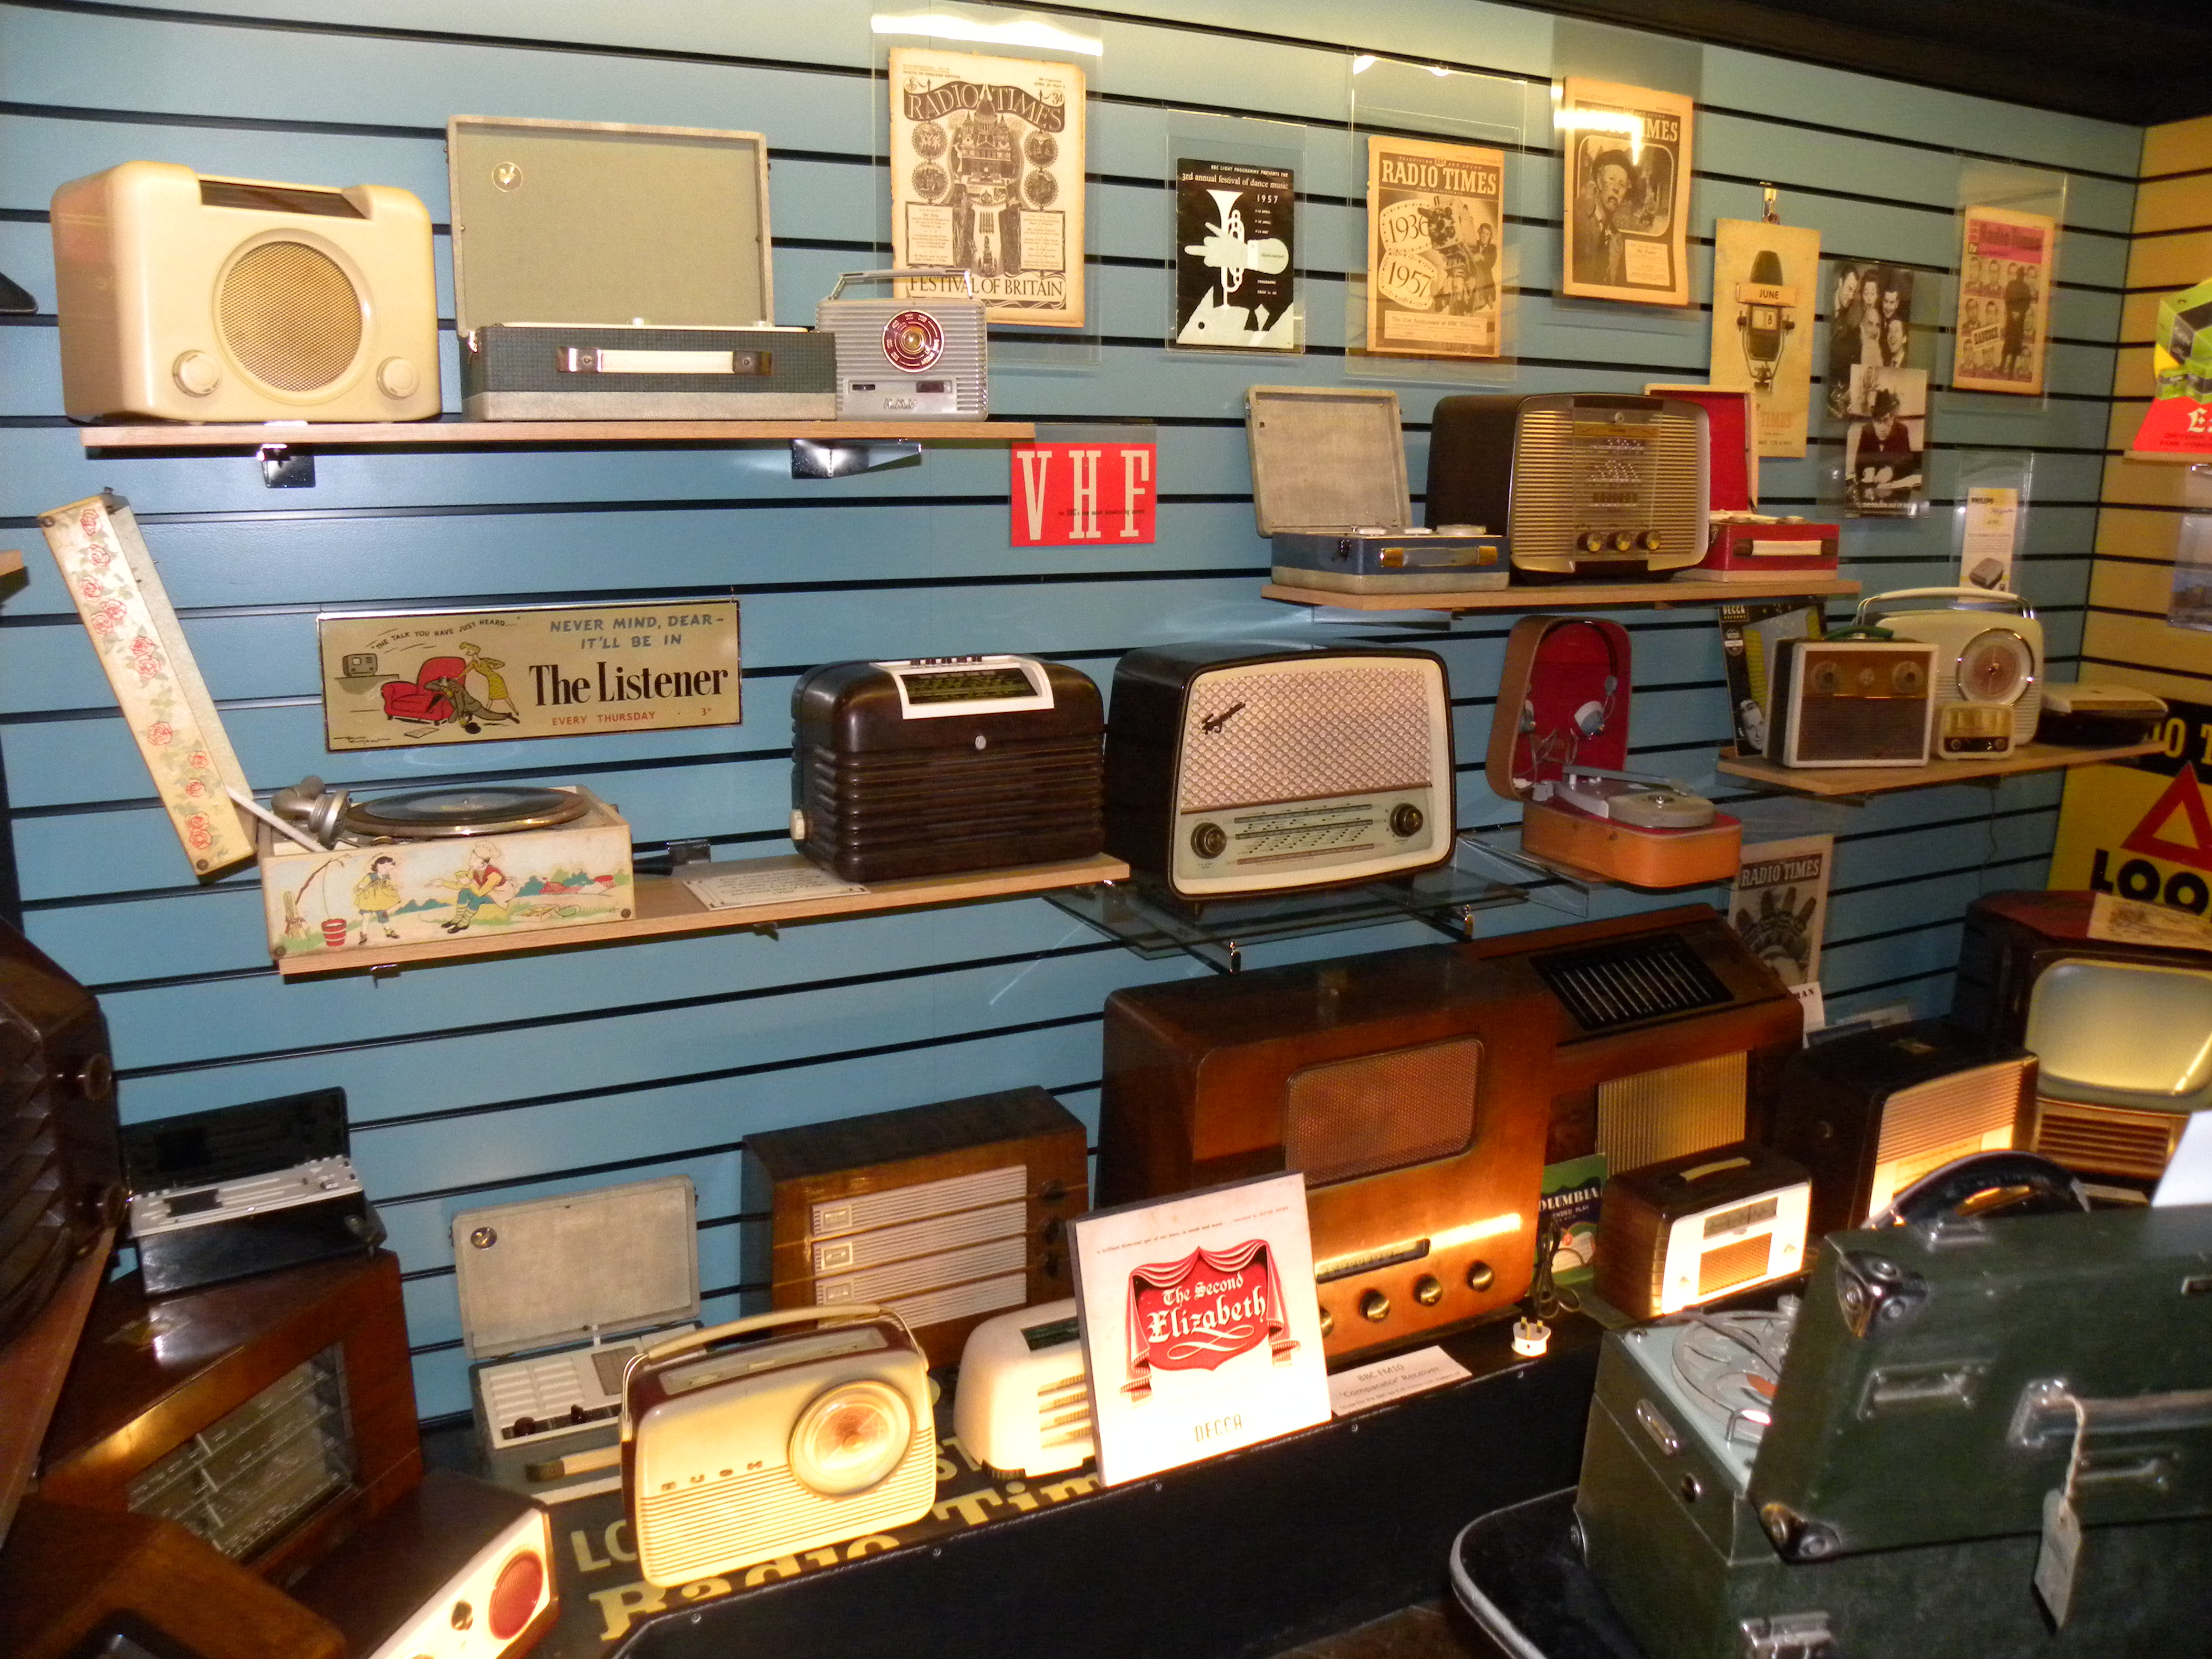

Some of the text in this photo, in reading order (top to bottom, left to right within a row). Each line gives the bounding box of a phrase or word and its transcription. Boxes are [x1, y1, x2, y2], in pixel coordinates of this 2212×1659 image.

[907, 84, 1062, 131] RADIO TIMES
[1182, 172, 1289, 190] 3rd annual festival of dance music
[1381, 159, 1497, 195] RADIO TIMES
[1256, 194, 1279, 205] 1957
[1388, 214, 1429, 243] 1936
[910, 276, 1063, 296] FESTIVAL OF BRITAIN
[1388, 261, 1432, 298] 1957
[1759, 289, 1780, 299] JUNE
[1767, 315, 1773, 325] 8
[1016, 450, 1149, 540] VHF
[1723, 605, 1745, 614] DECCA
[391, 632, 410, 641] TALK
[434, 628, 455, 637] HAVE
[458, 622, 477, 633] JUST
[550, 619, 604, 633] NEVER
[613, 616, 662, 630] MIND,
[581, 634, 683, 650] IT'LL BE IN
[529, 661, 729, 707] The Listener
[552, 715, 588, 727] EVERY
[597, 711, 656, 723] THURSDAY
[1742, 858, 1821, 886] RADIO TIMES
[1538, 1187, 1599, 1212] OLUMBIA
[1552, 1208, 1573, 1218] ENDED
[1162, 1271, 1244, 1307] The Second
[1146, 1285, 1266, 1343] Elizabeth
[1357, 1371, 1378, 1382] BBC
[1401, 1366, 1439, 1381] Receiver
[1195, 1414, 1243, 1442] DECCA
[661, 1460, 763, 1492] BUSH
